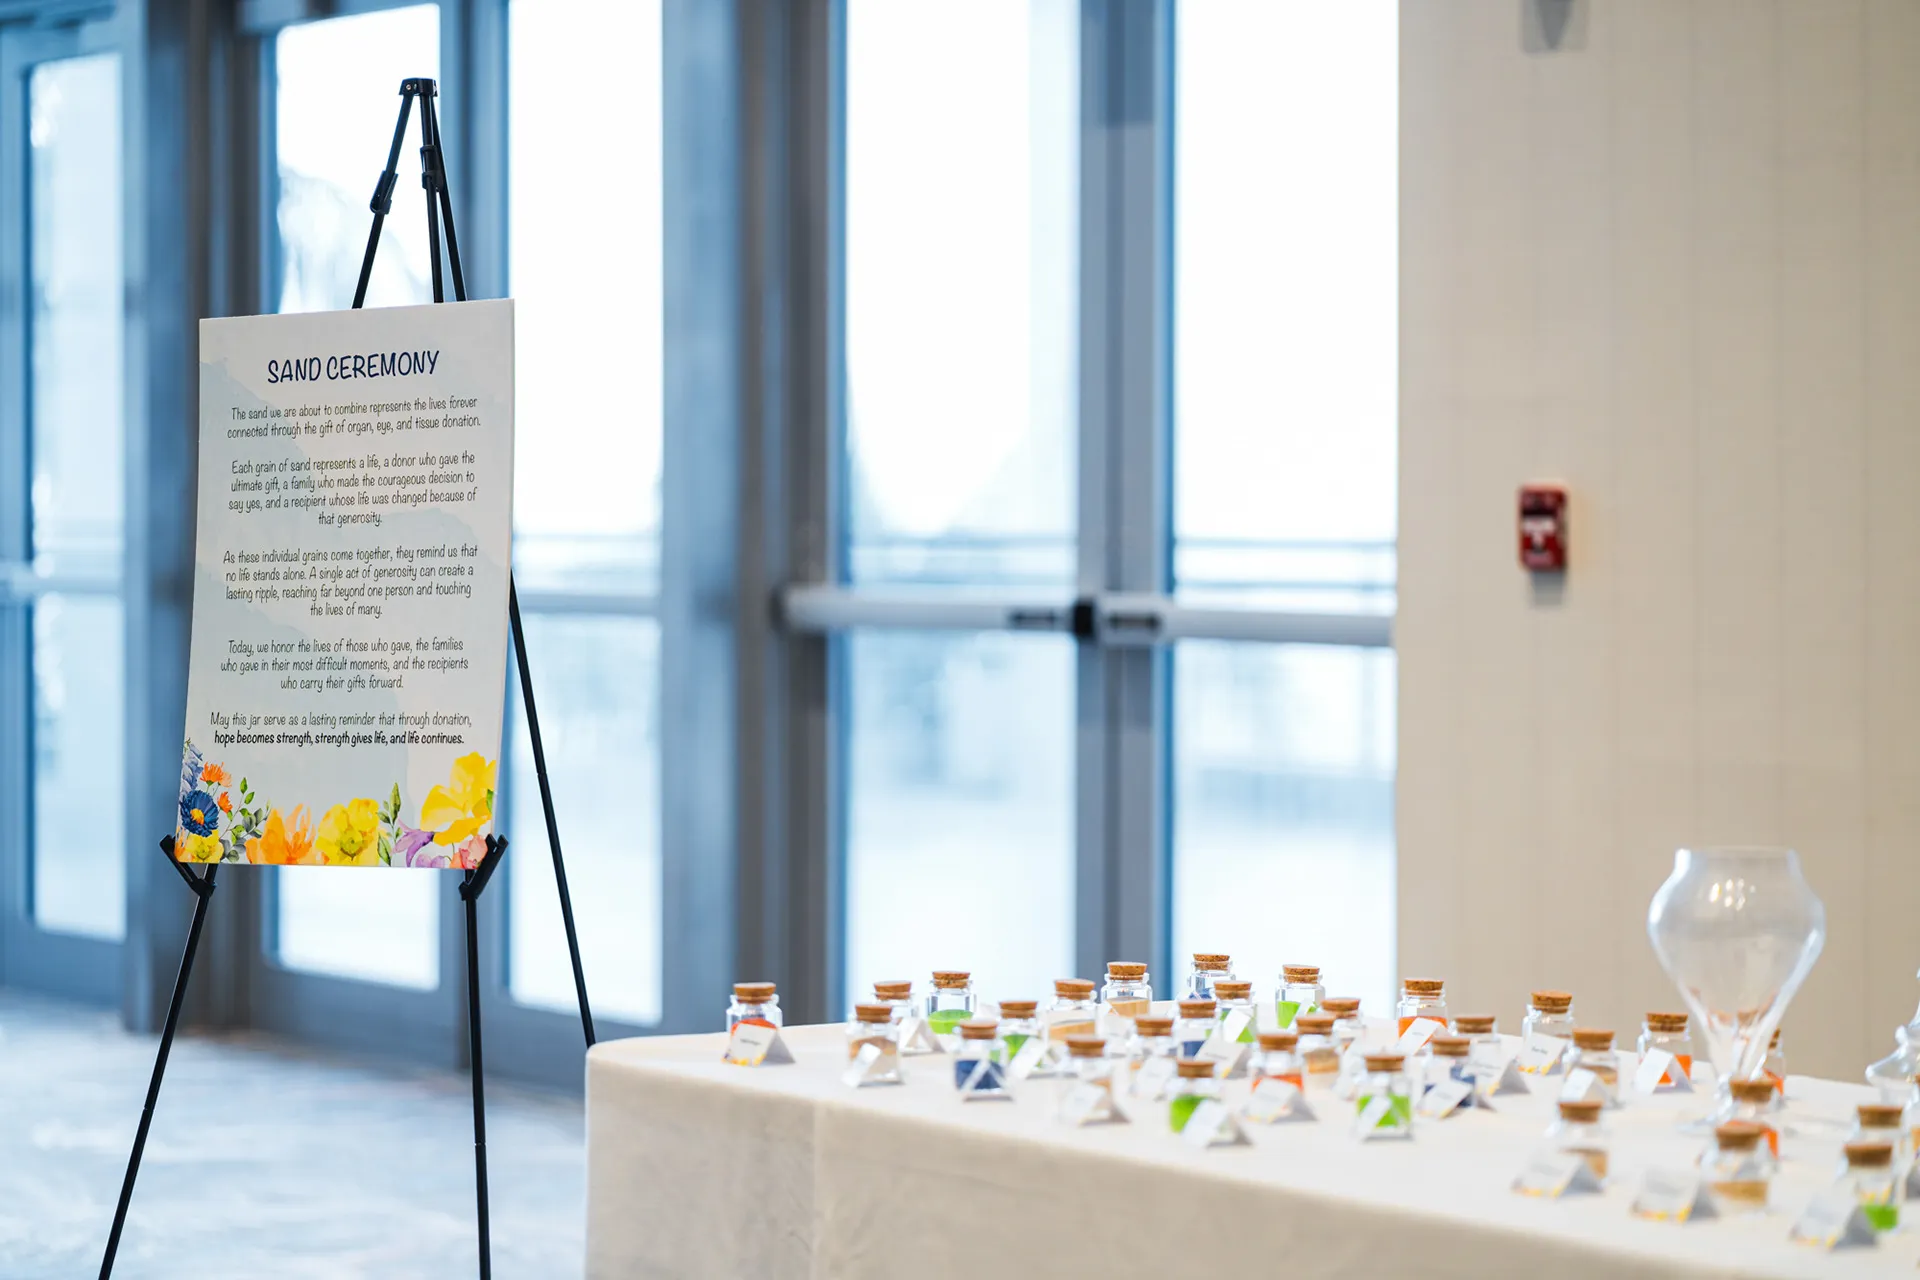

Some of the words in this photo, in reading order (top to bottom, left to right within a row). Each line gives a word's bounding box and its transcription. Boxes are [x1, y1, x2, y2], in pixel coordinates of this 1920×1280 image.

[267, 356, 322, 384] SAND
[326, 350, 440, 381] CEREMONY
[231, 407, 247, 421] The
[248, 405, 268, 420] sand
[269, 409, 282, 419] we
[283, 408, 297, 418] are
[298, 404, 321, 417] about
[323, 404, 333, 416] to
[333, 401, 368, 416] combine
[369, 400, 412, 418] represents
[413, 397, 427, 411] the
[428, 396, 447, 410] lives
[449, 395, 478, 410] forever
[227, 422, 269, 439] connected
[270, 421, 302, 440] through
[304, 420, 318, 435] the
[319, 419, 334, 438] gift
[335, 418, 347, 434] of
[347, 421, 375, 437] organ,
[376, 421, 394, 436] eye,
[395, 415, 413, 431] and
[415, 416, 440, 430] tissue
[441, 413, 481, 428] donation.
[231, 459, 254, 475] Each
[254, 460, 277, 478] grain
[278, 457, 289, 473] of
[290, 457, 311, 472] sand
[312, 457, 357, 475] represents
[358, 459, 365, 469] a
[366, 453, 381, 471] life,
[383, 458, 390, 468] a
[391, 453, 417, 468] donor
[418, 451, 437, 466] who
[438, 454, 459, 470] gave
[461, 449, 475, 465] the
[230, 477, 263, 493] ultimate
[264, 476, 281, 495] gift,
[282, 480, 289, 490] a
[290, 475, 316, 494] family
[317, 474, 335, 489] who
[336, 473, 360, 488] made
[361, 472, 376, 487] the
[377, 474, 426, 490] courageous
[428, 470, 464, 485] decision
[465, 470, 475, 483] to
[228, 500, 244, 514] say
[245, 499, 263, 514] yes,
[265, 494, 282, 509] and
[283, 498, 289, 508] a
[290, 494, 327, 512] recipient
[328, 492, 356, 507] whose
[357, 490, 370, 506] life
[371, 494, 390, 505] was
[391, 488, 428, 508] changed
[429, 488, 465, 503] because
[466, 486, 478, 502] of
[318, 510, 335, 525] that
[337, 510, 383, 529] generosity.
[222, 550, 236, 564] As
[237, 549, 260, 564] these
[261, 548, 301, 563] individual
[301, 549, 329, 566] grains
[330, 550, 354, 562] come
[356, 545, 393, 565] together,
[395, 545, 415, 563] they
[416, 543, 446, 559] remind
[447, 547, 458, 558] us
[460, 543, 478, 558] that
[225, 572, 237, 582] no
[238, 567, 251, 583] life
[252, 566, 281, 582] stands
[282, 566, 307, 581] alone.
[308, 565, 317, 581] A
[318, 564, 344, 584] single
[345, 566, 360, 579] act
[361, 563, 373, 579] of
[373, 564, 418, 583] generosity
[419, 566, 436, 578] can
[438, 564, 466, 577] create
[467, 565, 474, 576] a
[225, 585, 254, 604] lasting
[254, 584, 280, 604] ripple,
[282, 584, 318, 602] reaching
[320, 583, 333, 598] far
[334, 582, 366, 602] beyond
[366, 586, 384, 598] one
[384, 585, 414, 601] person
[416, 580, 433, 596] and
[435, 580, 472, 599] touching
[310, 604, 323, 616] the
[325, 601, 344, 616] lives
[345, 601, 357, 616] of
[357, 605, 383, 620] many.
[228, 639, 255, 658] Today,
[256, 643, 270, 653] we
[270, 639, 296, 654] honor
[297, 638, 311, 653] the
[312, 638, 332, 653] lives
[333, 637, 345, 653] of
[345, 638, 369, 653] those
[370, 637, 389, 652] who
[390, 641, 413, 656] gave,
[415, 637, 430, 652] the
[431, 636, 464, 651] families
[220, 657, 238, 672] who
[239, 661, 260, 676] gave
[260, 658, 269, 671] in
[271, 657, 291, 672] their
[292, 658, 314, 672] most
[315, 655, 348, 671] difficult
[349, 658, 391, 673] moments,
[392, 655, 410, 671] and
[411, 655, 426, 670] the
[427, 656, 469, 674] recipients
[280, 675, 298, 690] who
[299, 679, 324, 694] carry
[325, 674, 346, 689] their
[346, 674, 366, 693] gifts
[368, 673, 404, 689] forward.
[210, 711, 230, 730] May
[232, 712, 247, 726] this
[246, 714, 262, 731] jar
[263, 715, 287, 726] serve
[288, 715, 299, 726] as
[300, 716, 308, 726] a
[308, 711, 337, 730] lasting
[338, 711, 376, 726] reminder
[378, 711, 396, 726] that
[398, 711, 430, 730] through
[432, 711, 472, 728] donation,
[214, 729, 236, 748] hope
[236, 729, 275, 744] becomes
[275, 729, 314, 748] strength,
[314, 730, 351, 748] strength
[350, 731, 373, 748] gives
[373, 730, 389, 747] life,
[389, 730, 407, 745] and
[407, 730, 420, 744] life
[420, 731, 465, 745] continues.
